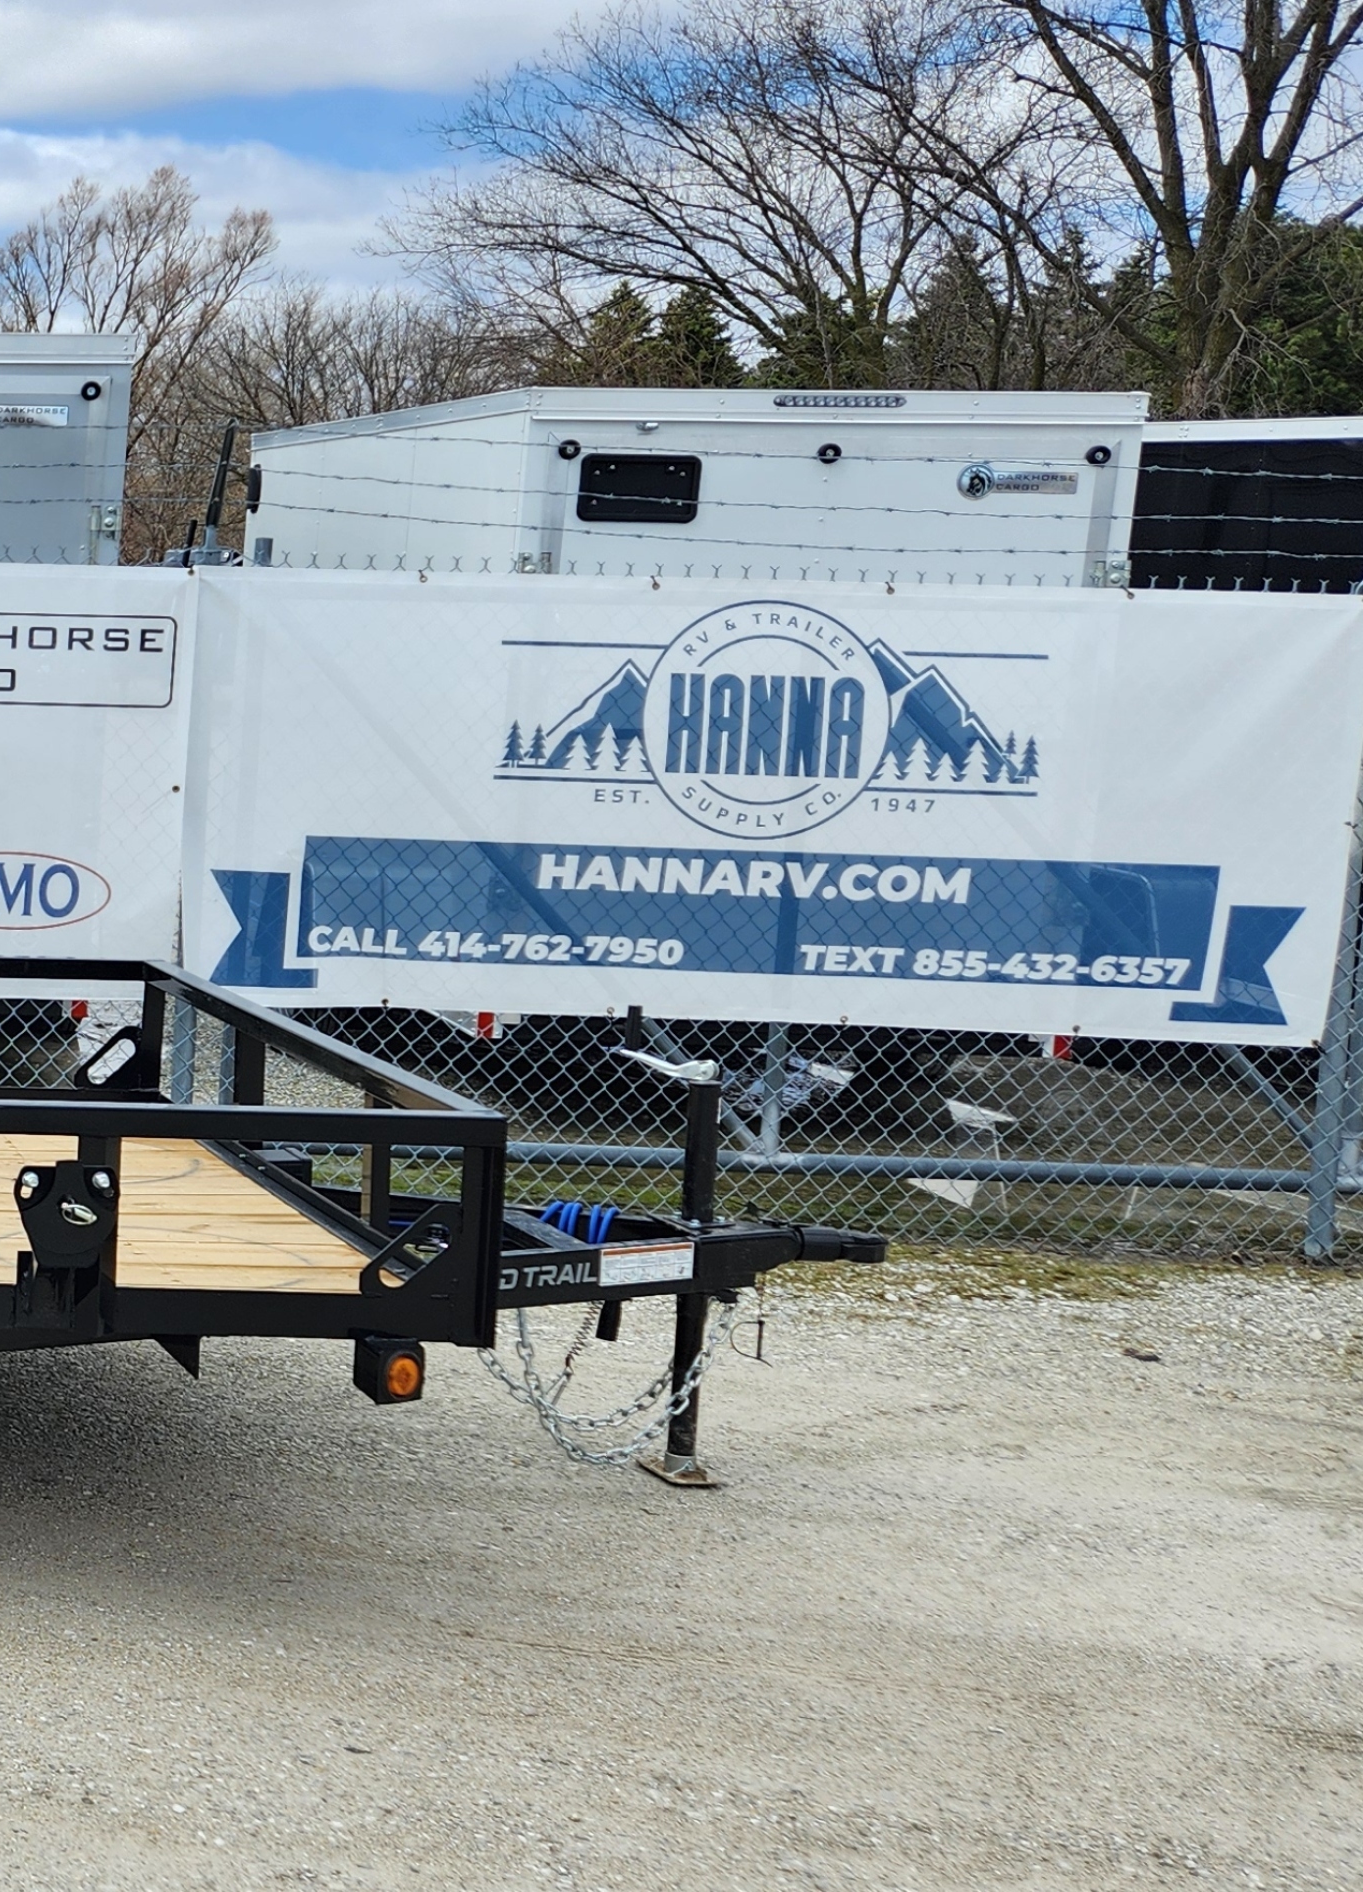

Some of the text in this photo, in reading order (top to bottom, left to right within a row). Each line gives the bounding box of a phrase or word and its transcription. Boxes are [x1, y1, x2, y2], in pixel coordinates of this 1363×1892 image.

[683, 612, 856, 661] RV & TRAILER
[665, 672, 866, 779] HANNA
[594, 789, 650, 804] EST.
[681, 786, 785, 828] SUPPLY
[871, 798, 936, 814] 1947
[536, 853, 972, 904] HANNARV.COM
[307, 925, 684, 966] CALL 414-762-7950
[800, 944, 1191, 985] TEXT 855-432-6357
[520, 1262, 599, 1287] TRAIL
